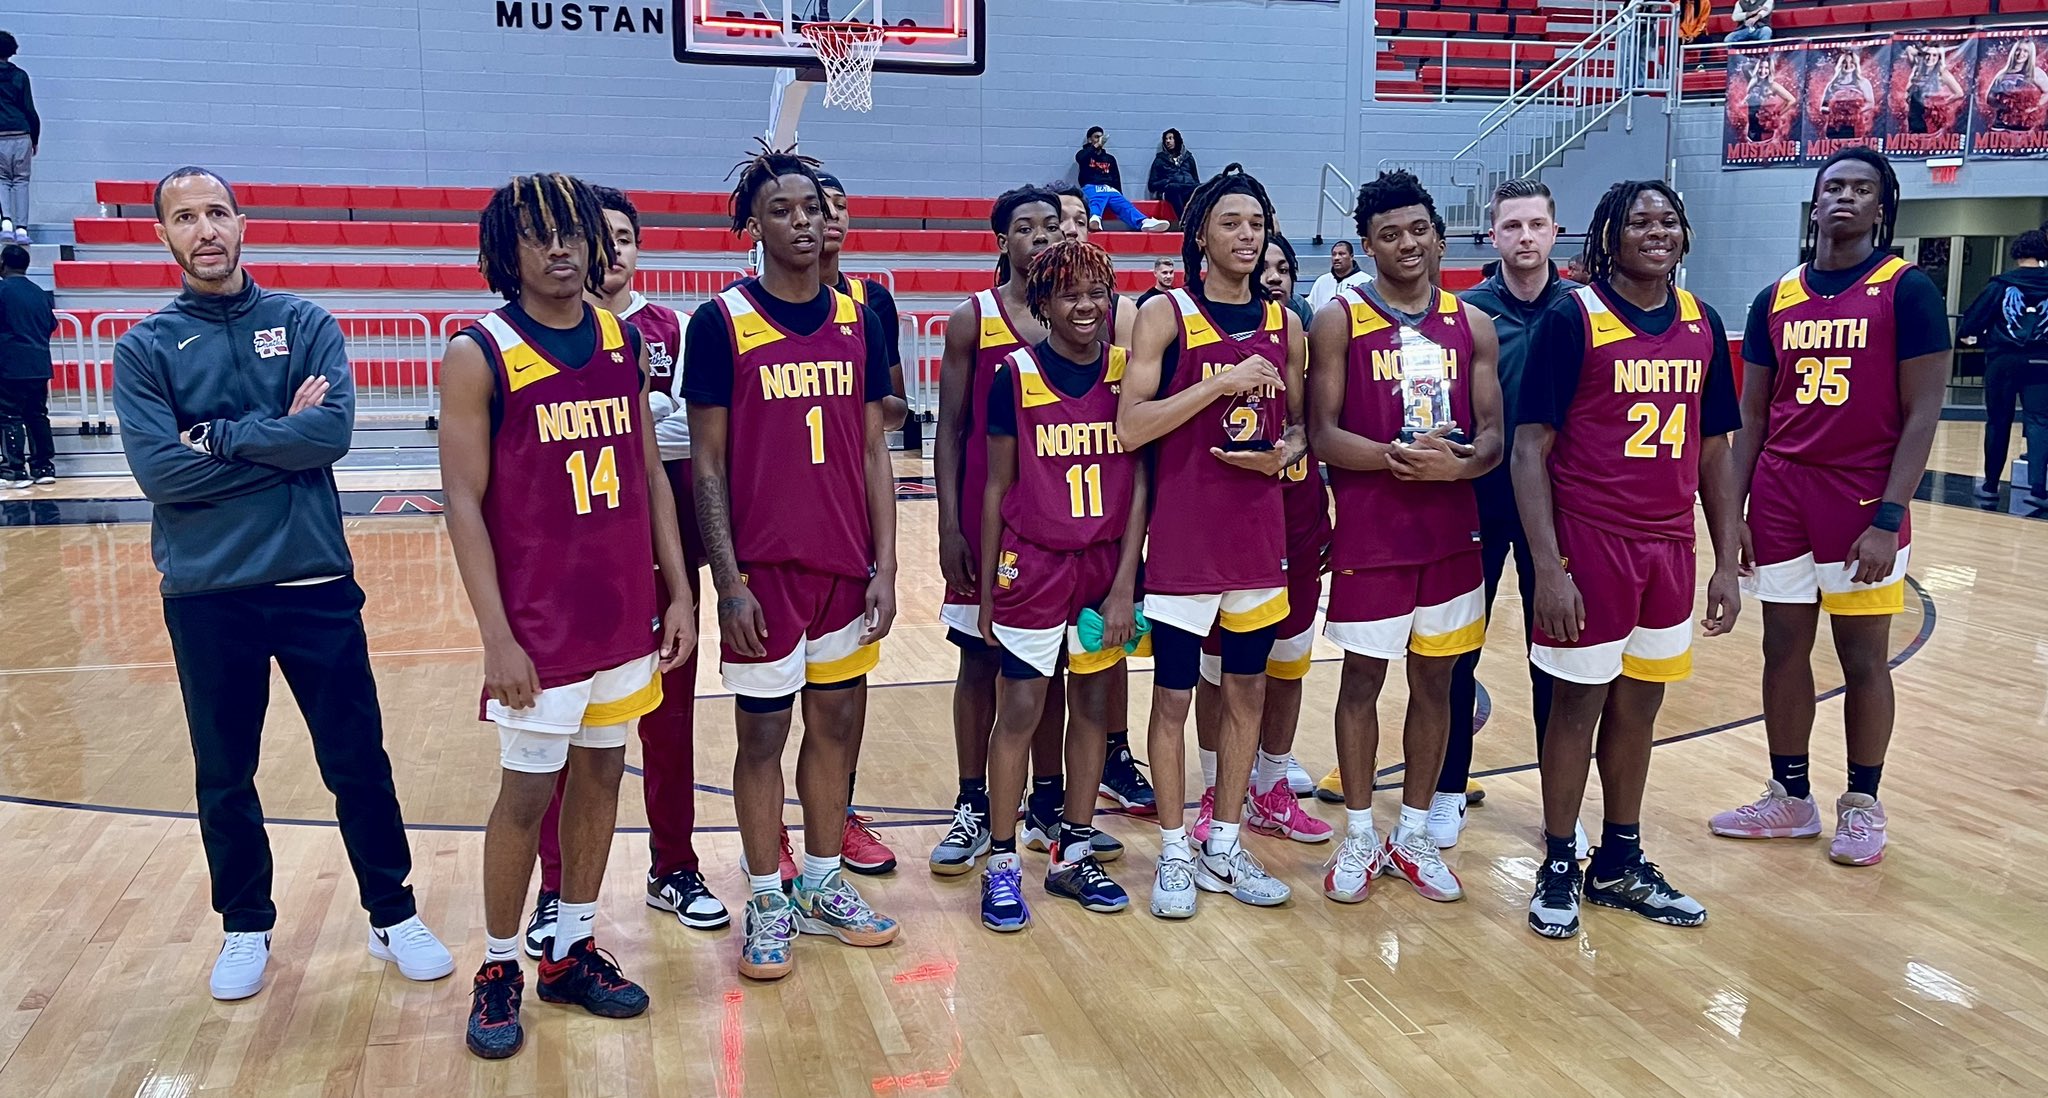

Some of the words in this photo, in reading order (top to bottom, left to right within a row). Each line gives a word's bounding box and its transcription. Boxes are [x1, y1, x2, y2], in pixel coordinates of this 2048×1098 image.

[496, 1, 663, 34] MUSTAN
[1727, 140, 1795, 159] MUSTANG
[1886, 132, 1960, 150] MUSTANG
[1782, 318, 1868, 350] NORTH
[759, 360, 854, 401] NORTH
[1371, 348, 1458, 382] NOH
[1613, 359, 1702, 393] NORTH
[1795, 356, 1852, 406] 35
[535, 396, 632, 443] NORTH
[805, 405, 825, 465] 1
[1624, 402, 1687, 459] 24
[1036, 421, 1124, 457] NORTH
[565, 445, 620, 515] 14
[1065, 463, 1104, 518] 11
